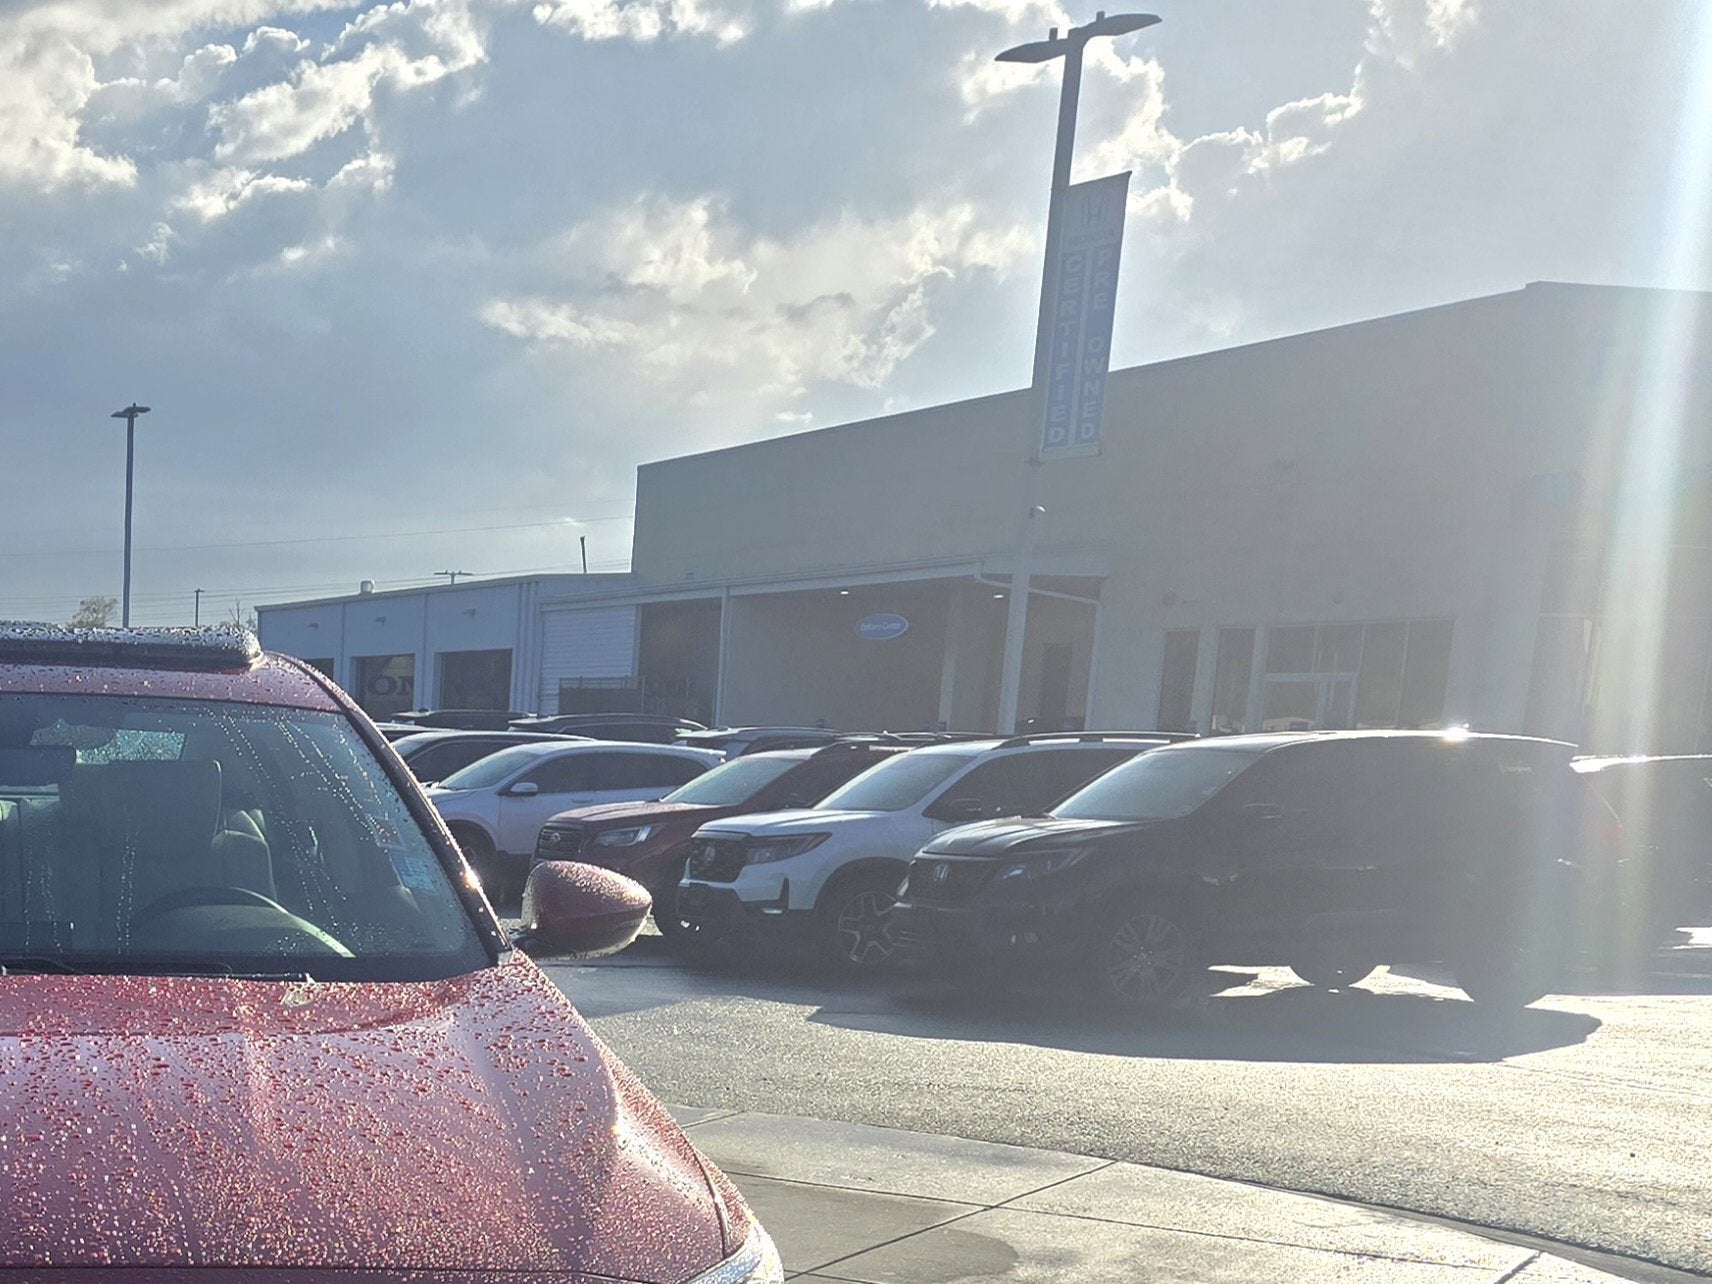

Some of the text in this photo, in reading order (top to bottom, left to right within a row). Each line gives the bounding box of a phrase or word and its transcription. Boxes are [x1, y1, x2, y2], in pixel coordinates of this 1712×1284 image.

[1048, 255, 1083, 443] CERTIFIED
[1080, 248, 1112, 440] PRE OWNED
